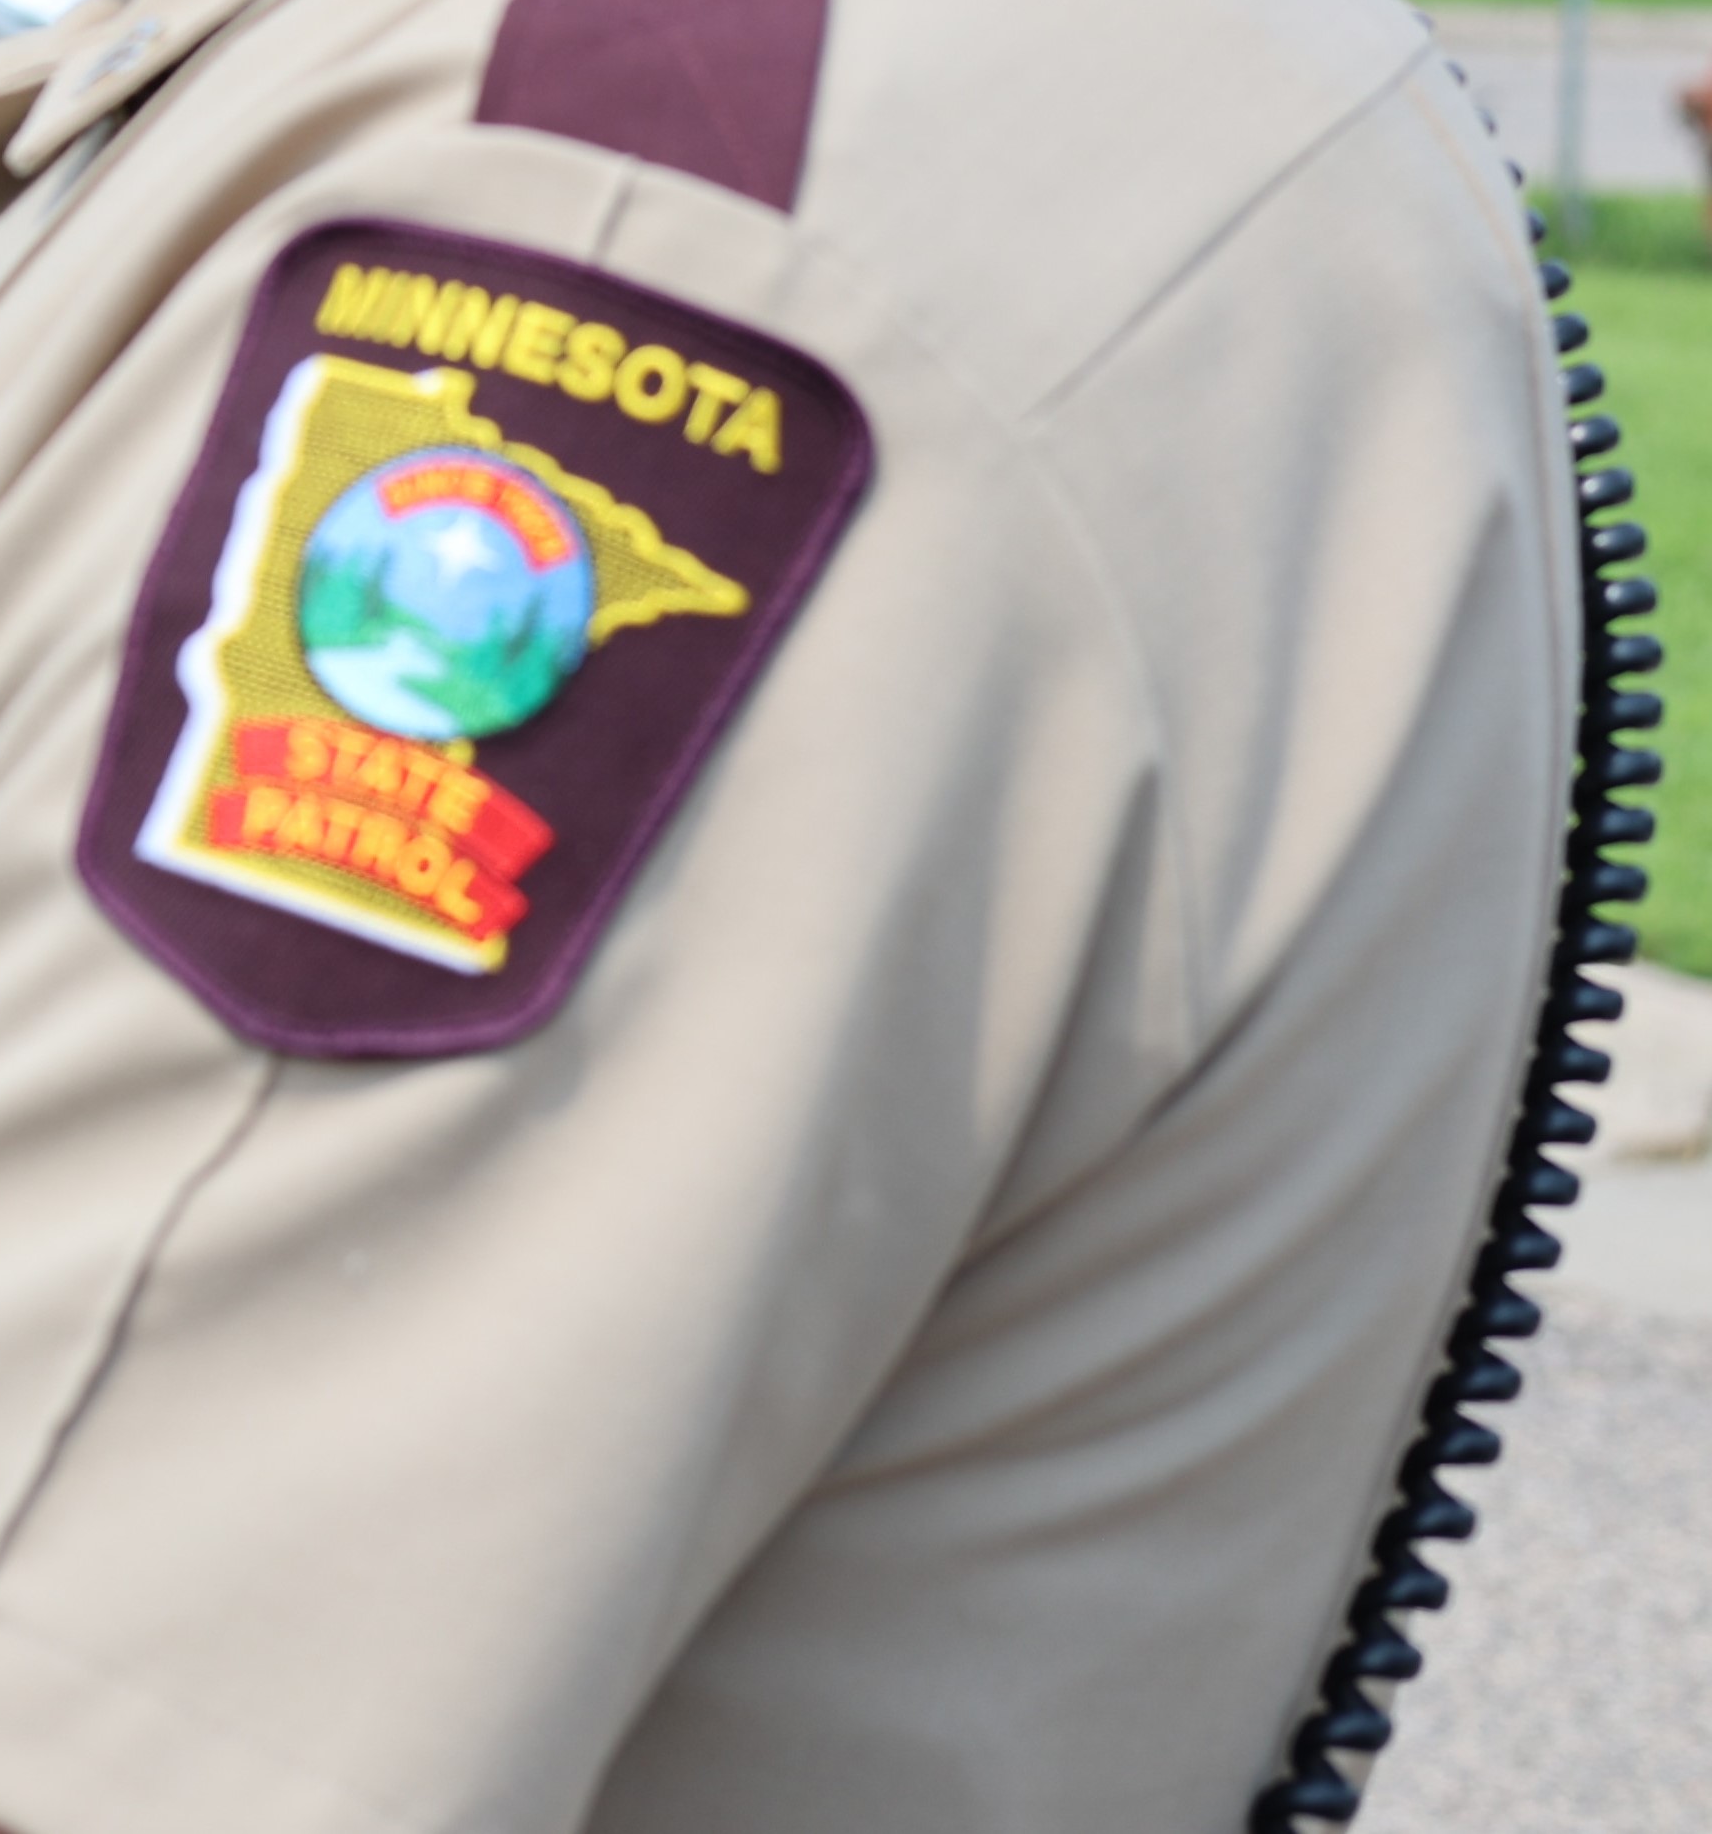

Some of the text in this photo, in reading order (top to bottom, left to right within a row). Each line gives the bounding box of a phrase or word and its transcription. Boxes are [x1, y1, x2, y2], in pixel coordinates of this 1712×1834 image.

[316, 262, 783, 475] MINNESOTA
[287, 721, 491, 834] STATE
[242, 786, 484, 923] PATROL
